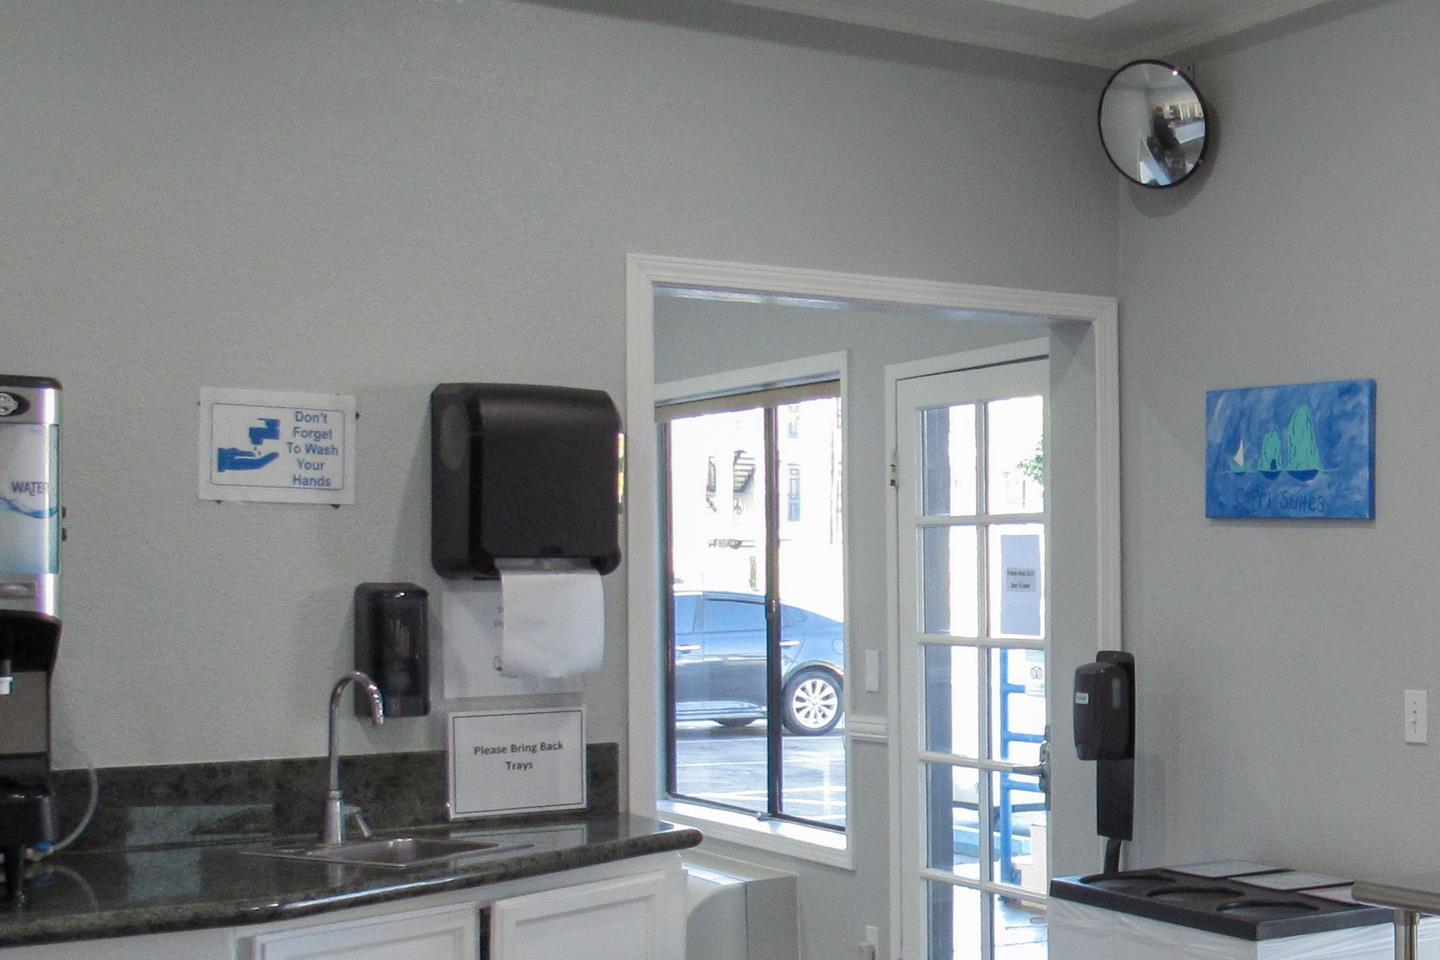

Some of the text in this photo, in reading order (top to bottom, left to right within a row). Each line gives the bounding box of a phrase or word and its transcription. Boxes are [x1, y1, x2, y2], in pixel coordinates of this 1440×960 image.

[295, 410, 328, 424] Don't
[293, 426, 333, 441] Forget
[286, 442, 338, 456] To Wash
[297, 458, 326, 471] Your
[293, 474, 332, 487] Hands
[474, 741, 564, 755] Please Bring Back
[506, 761, 534, 771] Trays
